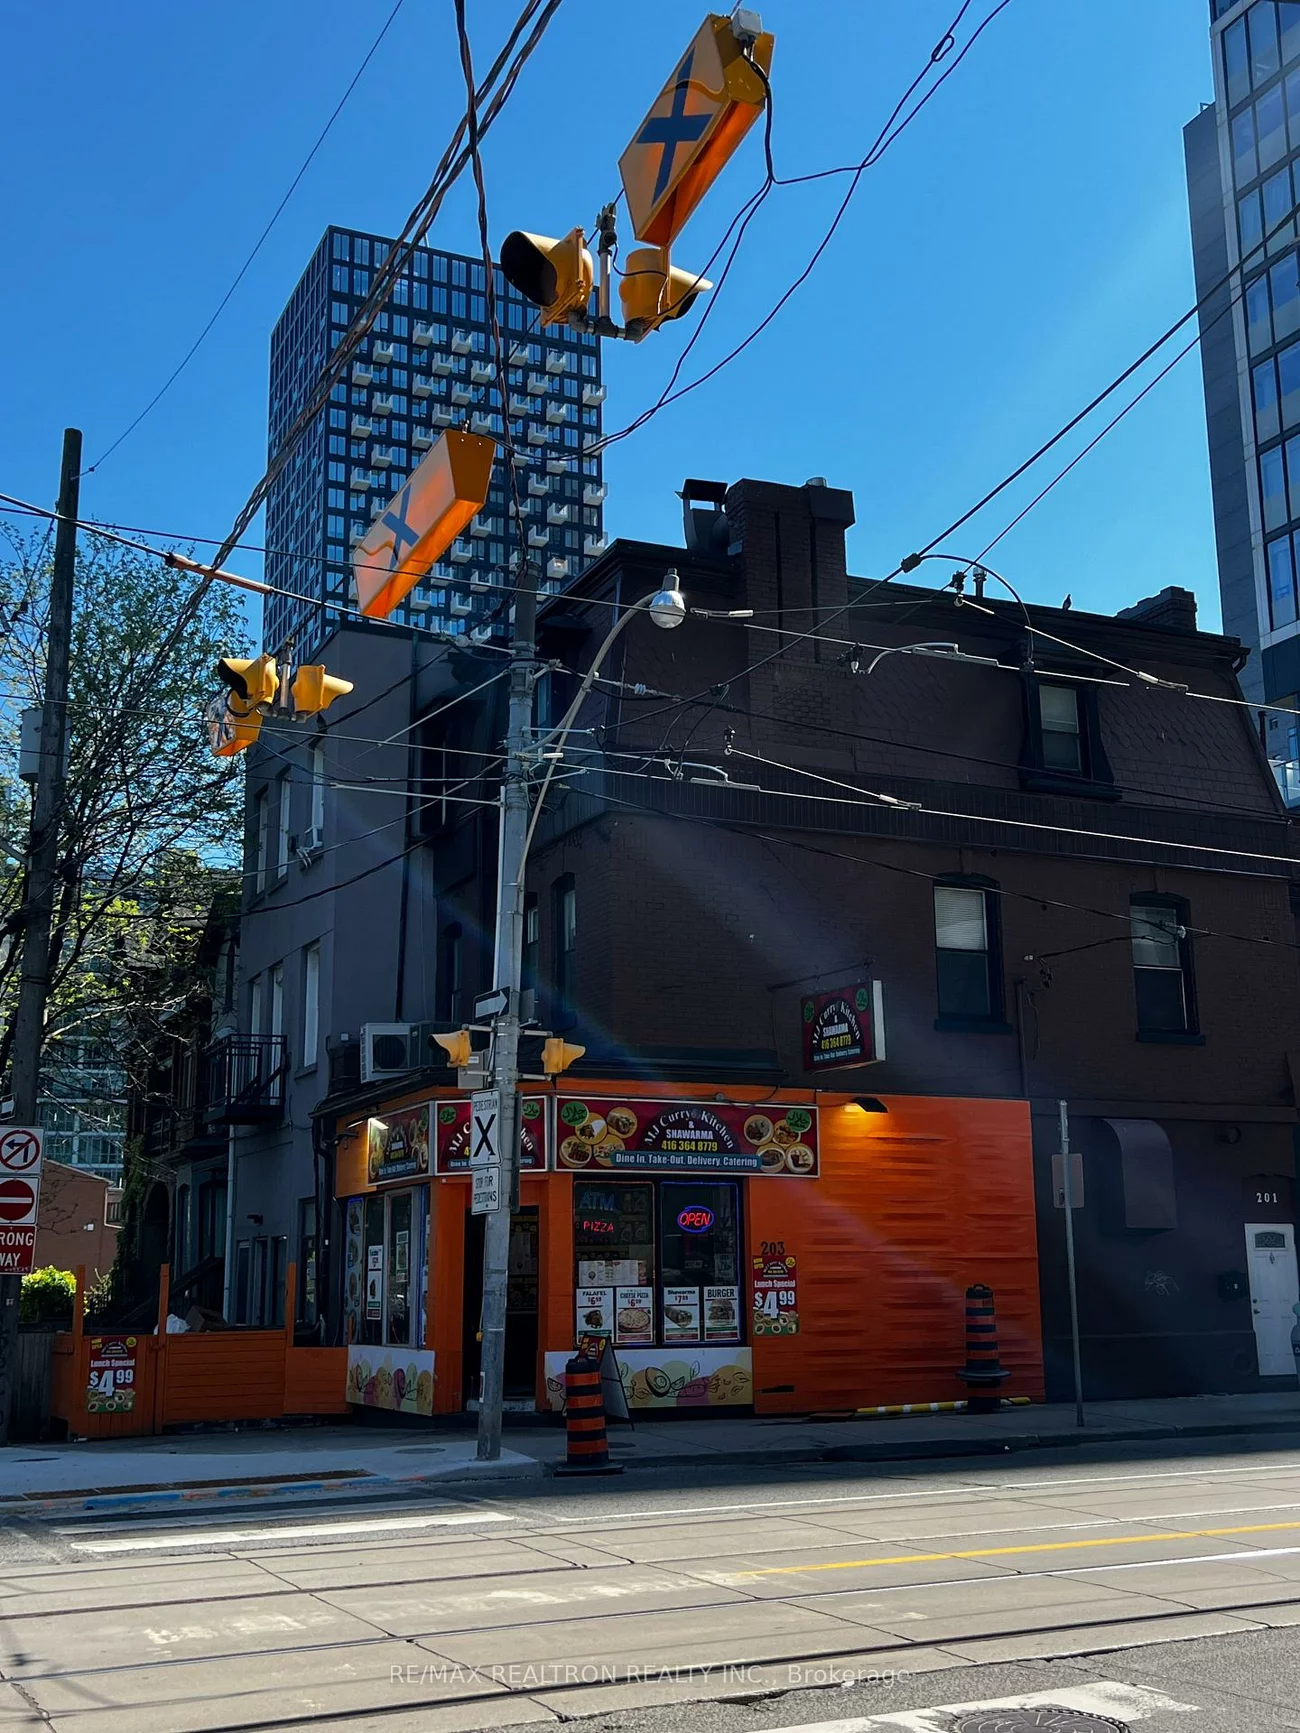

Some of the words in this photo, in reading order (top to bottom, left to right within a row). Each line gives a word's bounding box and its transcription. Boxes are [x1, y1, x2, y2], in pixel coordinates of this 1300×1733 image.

[820, 1003, 836, 1026] Curry
[841, 1001, 861, 1040] Kitchen
[644, 1124, 661, 1146] MJ
[660, 1110, 690, 1127] Curry
[701, 1111, 734, 1149] Kitchen
[688, 1120, 695, 1129] &
[666, 1128, 714, 1140] SHAWARMA
[448, 1132, 464, 1156] MJ
[661, 1140, 677, 1150] 416
[678, 1140, 696, 1151] 364
[697, 1141, 718, 1152] 8779
[615, 1153, 636, 1164] Dine
[723, 1156, 758, 1168] Catering
[580, 1190, 615, 1212] ATM
[1256, 1192, 1278, 1203] 201
[582, 1219, 615, 1233] PIZZA
[679, 1211, 712, 1227] OPEN
[760, 1241, 785, 1256] 203
[754, 1279, 772, 1288] Lunch
[773, 1279, 796, 1288] Special
[707, 1288, 735, 1298] BURGER
[90, 1358, 111, 1368] Lunch
[111, 1358, 136, 1368] Special
